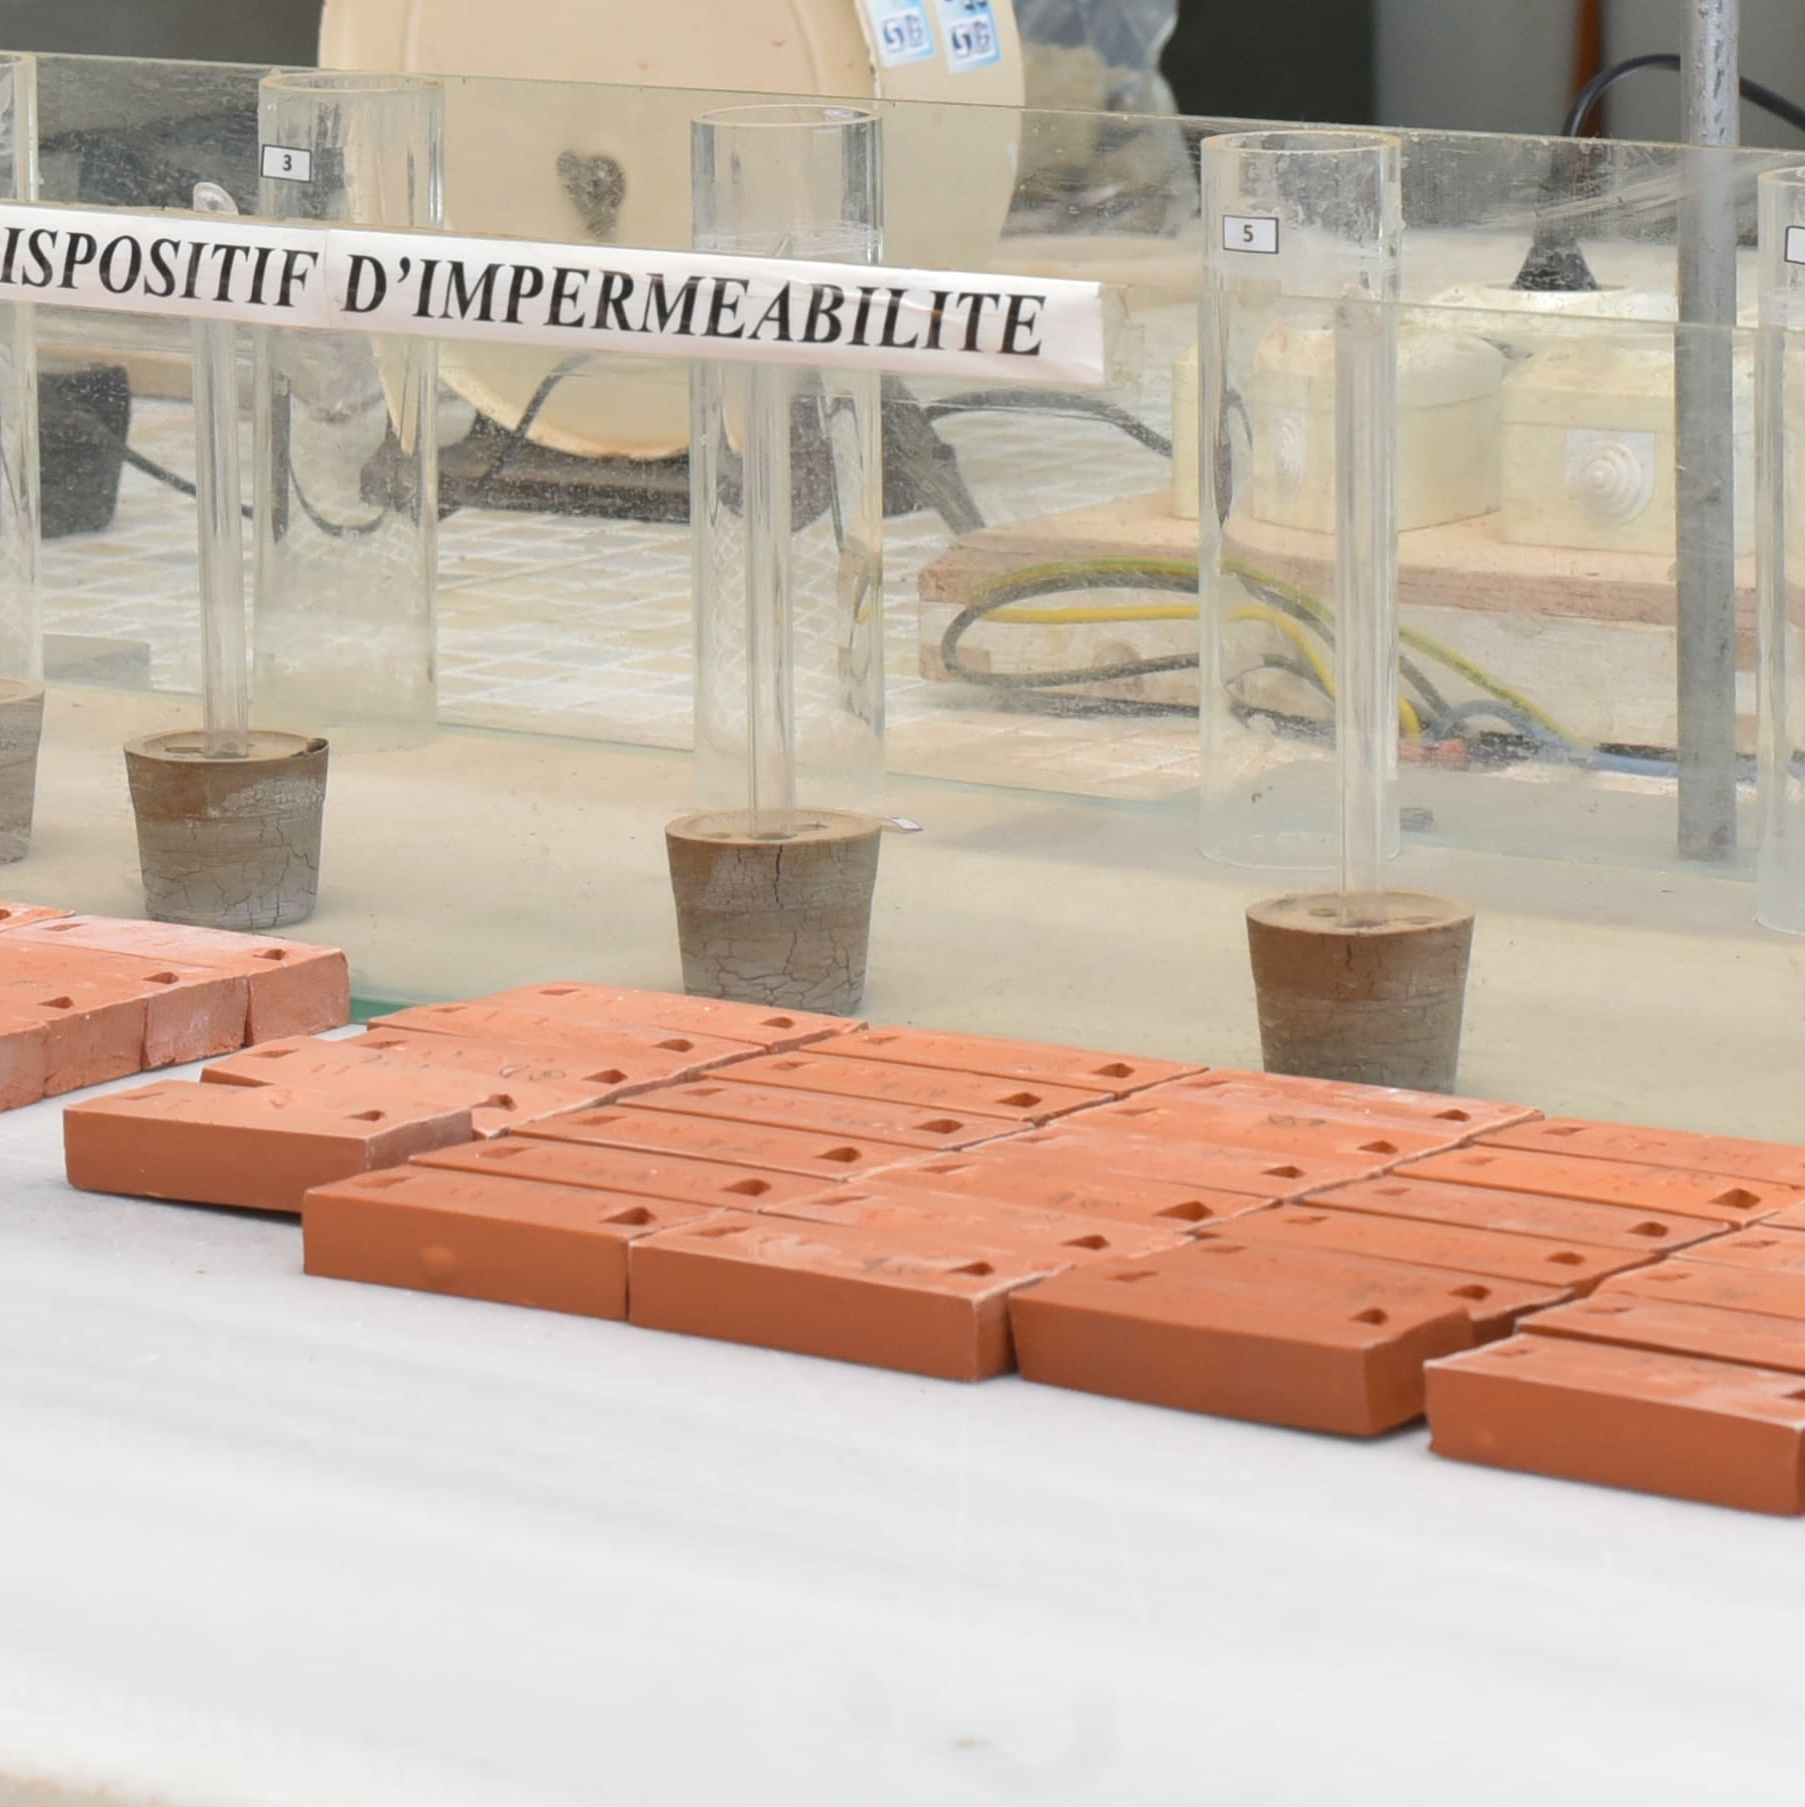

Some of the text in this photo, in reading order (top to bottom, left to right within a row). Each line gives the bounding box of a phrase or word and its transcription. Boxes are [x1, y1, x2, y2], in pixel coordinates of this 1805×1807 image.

[282, 154, 294, 173] 3
[1242, 225, 1254, 244] 5
[339, 252, 1048, 358] D'IMPERMEABILITE
